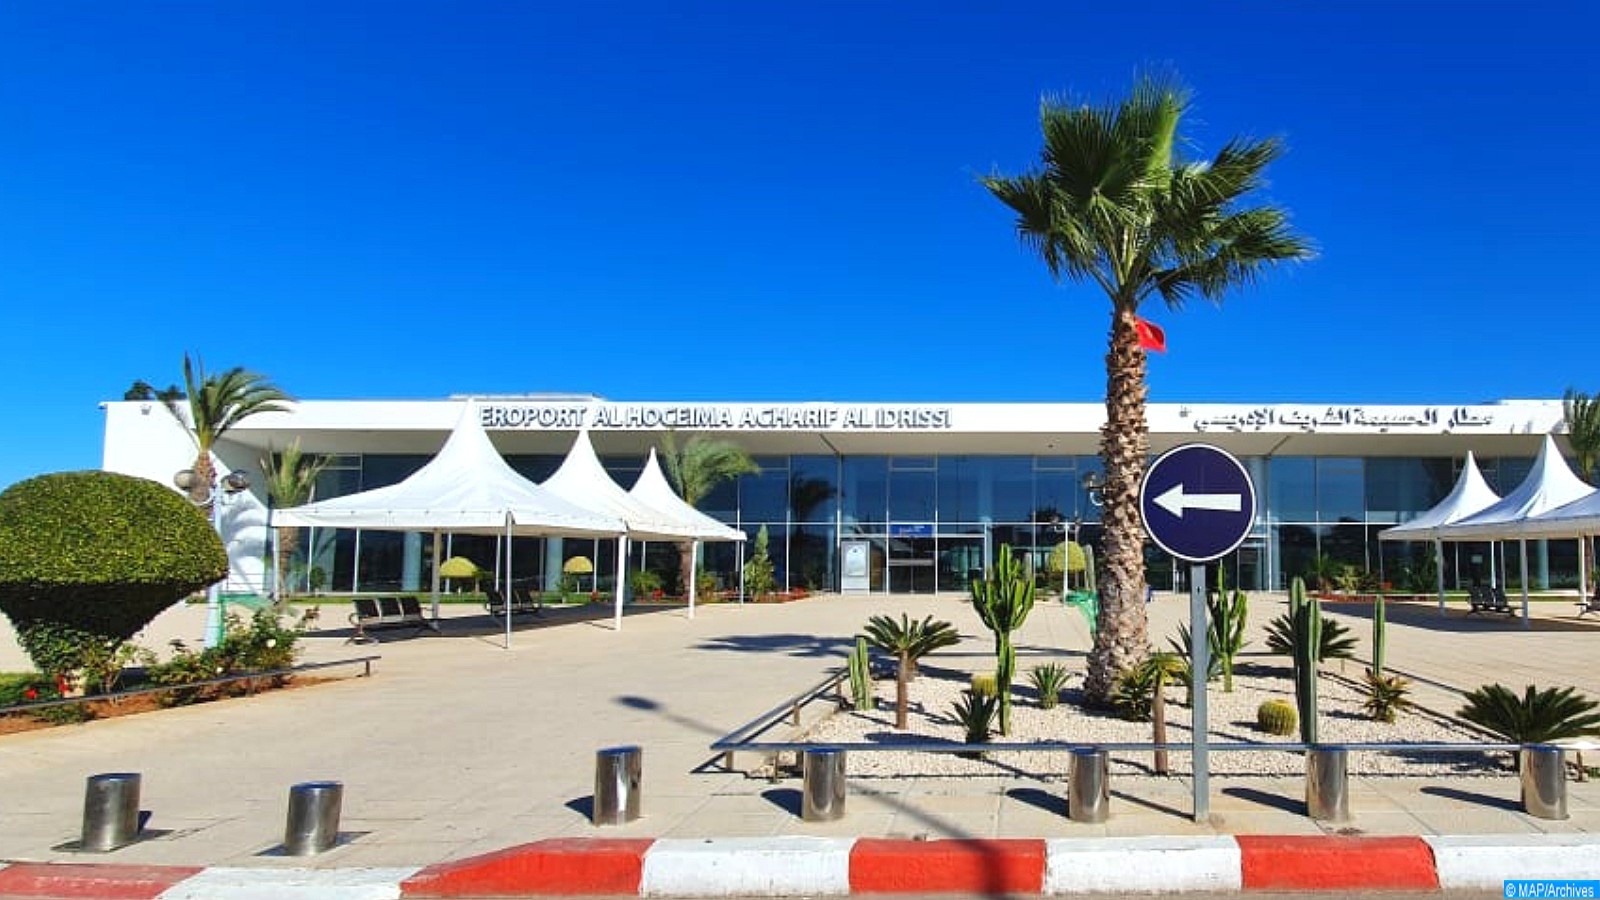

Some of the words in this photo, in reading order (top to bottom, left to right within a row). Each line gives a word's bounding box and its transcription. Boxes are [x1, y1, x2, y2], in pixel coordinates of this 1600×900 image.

[480, 406, 586, 427] EROPORT
[592, 406, 623, 427] AL
[626, 406, 733, 427] HOCEIMA
[738, 406, 839, 428] ACHARIF
[843, 407, 873, 428] AL
[875, 407, 952, 428] IDRISSI
